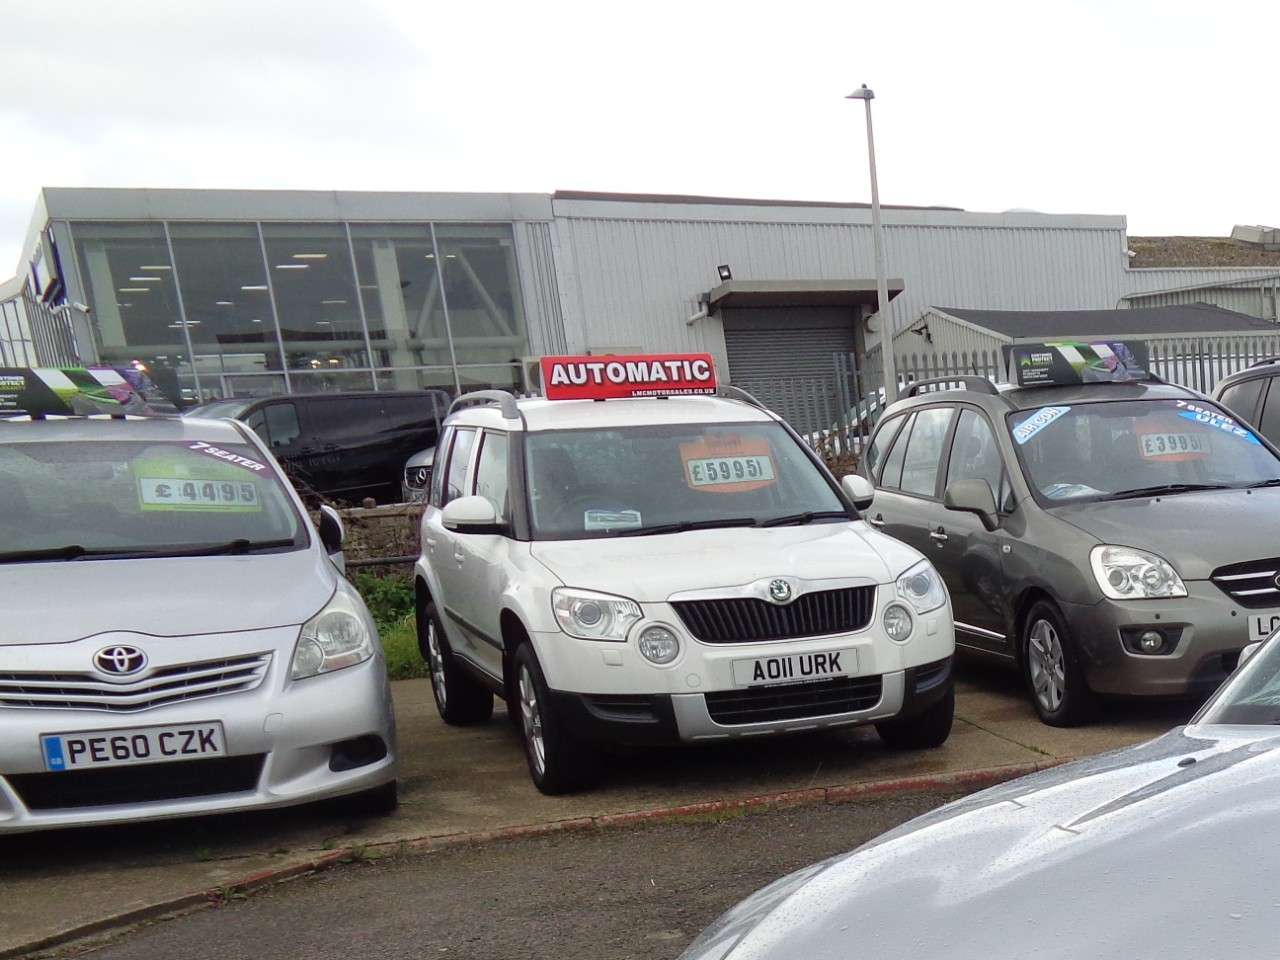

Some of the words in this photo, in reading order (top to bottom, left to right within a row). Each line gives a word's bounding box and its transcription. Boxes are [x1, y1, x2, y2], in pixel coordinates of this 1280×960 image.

[551, 360, 711, 385] AUTOMATIC
[190, 441, 210, 449] 7
[204, 447, 265, 471] SEATER
[799, 651, 842, 676] URK
[67, 734, 150, 764] PE60
[158, 729, 218, 756] CZK
